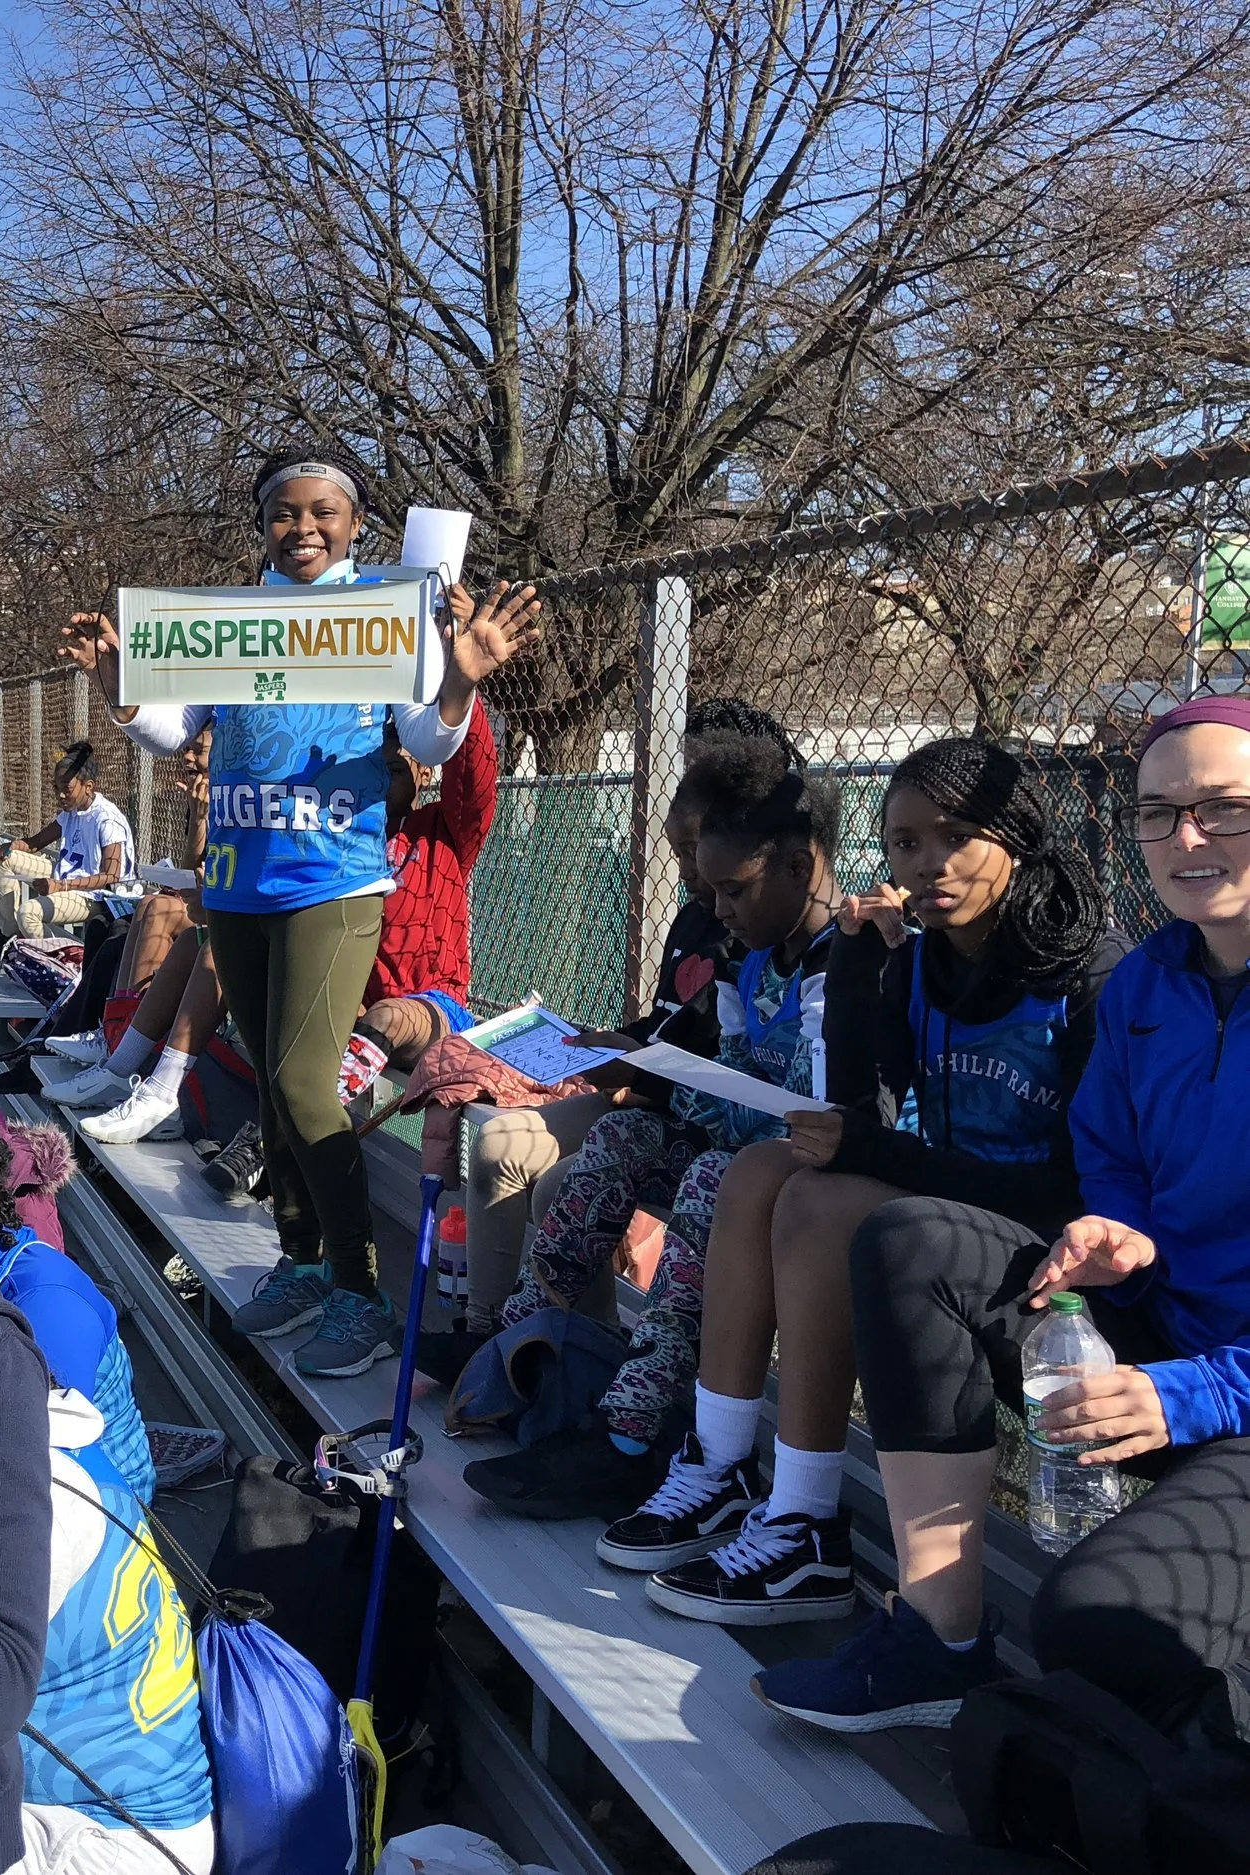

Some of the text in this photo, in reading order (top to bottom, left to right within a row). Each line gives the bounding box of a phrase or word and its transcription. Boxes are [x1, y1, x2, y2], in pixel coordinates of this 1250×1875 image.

[129, 616, 416, 659] #JASPERNATION
[211, 784, 356, 834] TIGERS
[491, 1019, 535, 1045] JASPERS
